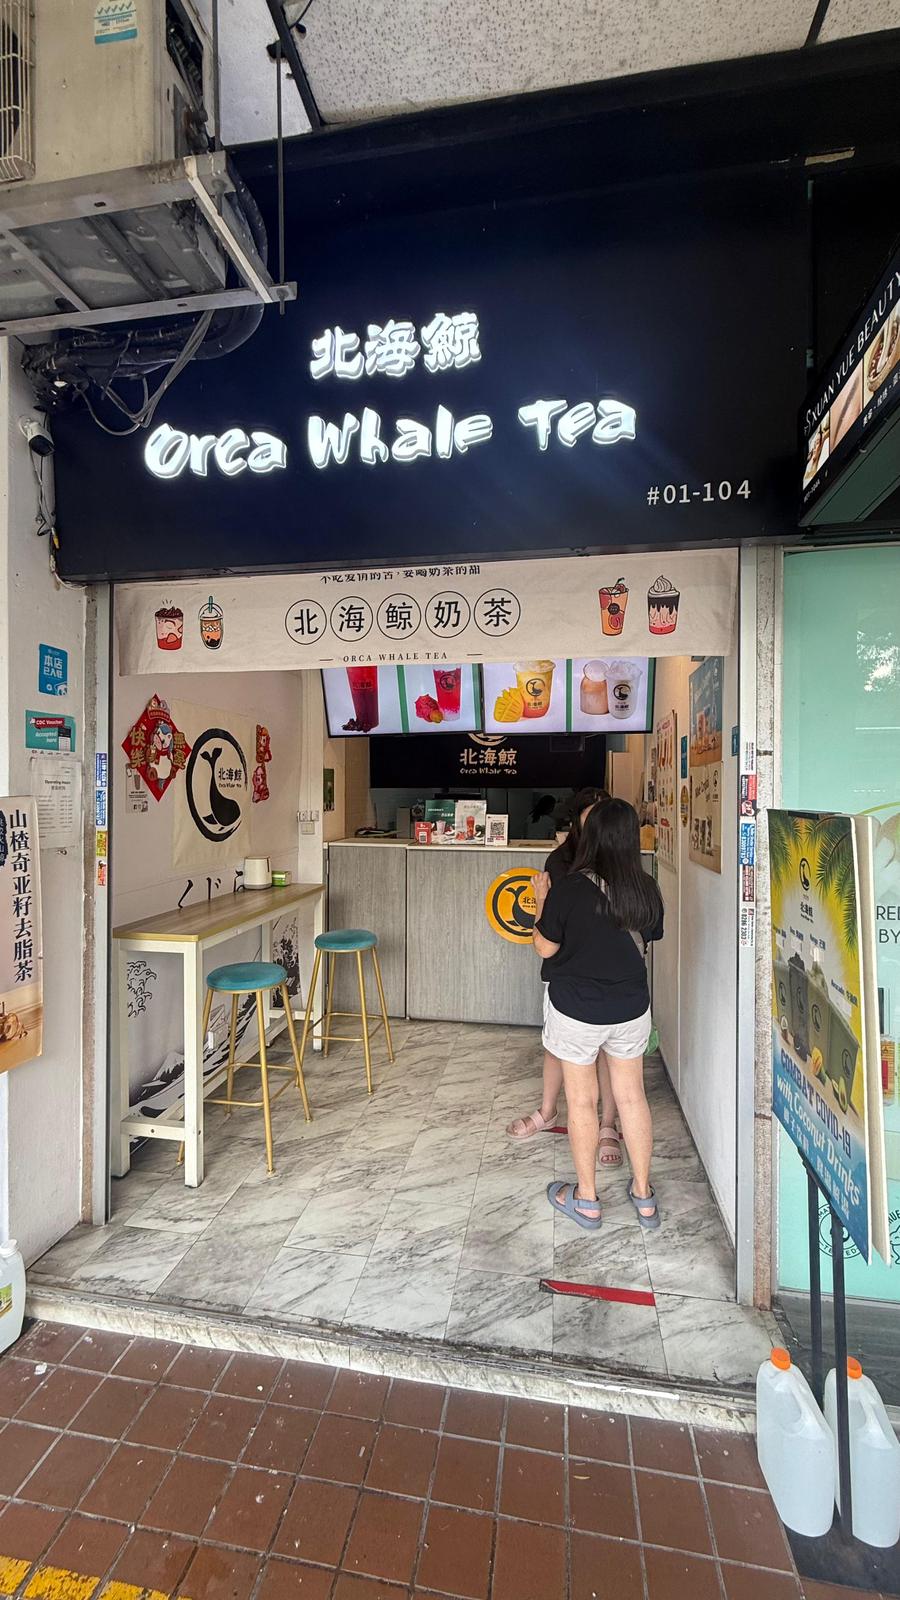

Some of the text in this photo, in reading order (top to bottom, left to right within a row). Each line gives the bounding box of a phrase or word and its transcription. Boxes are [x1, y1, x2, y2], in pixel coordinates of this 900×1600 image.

[836, 346, 855, 384] YUE
[144, 397, 638, 479] Orca Whale Tea
[647, 480, 751, 505] #01-104
[294, 597, 513, 636] 北海鲸奶茶
[44, 655, 63, 670] 本店
[343, 651, 448, 663] ORCA WHALE TEA
[479, 767, 502, 775] Whale
[9, 809, 34, 984] 山楂奇亚籽去脂茶
[780, 1047, 851, 1160] COMBAT COVID-19
[777, 1074, 860, 1206] with Coconut Drinks
